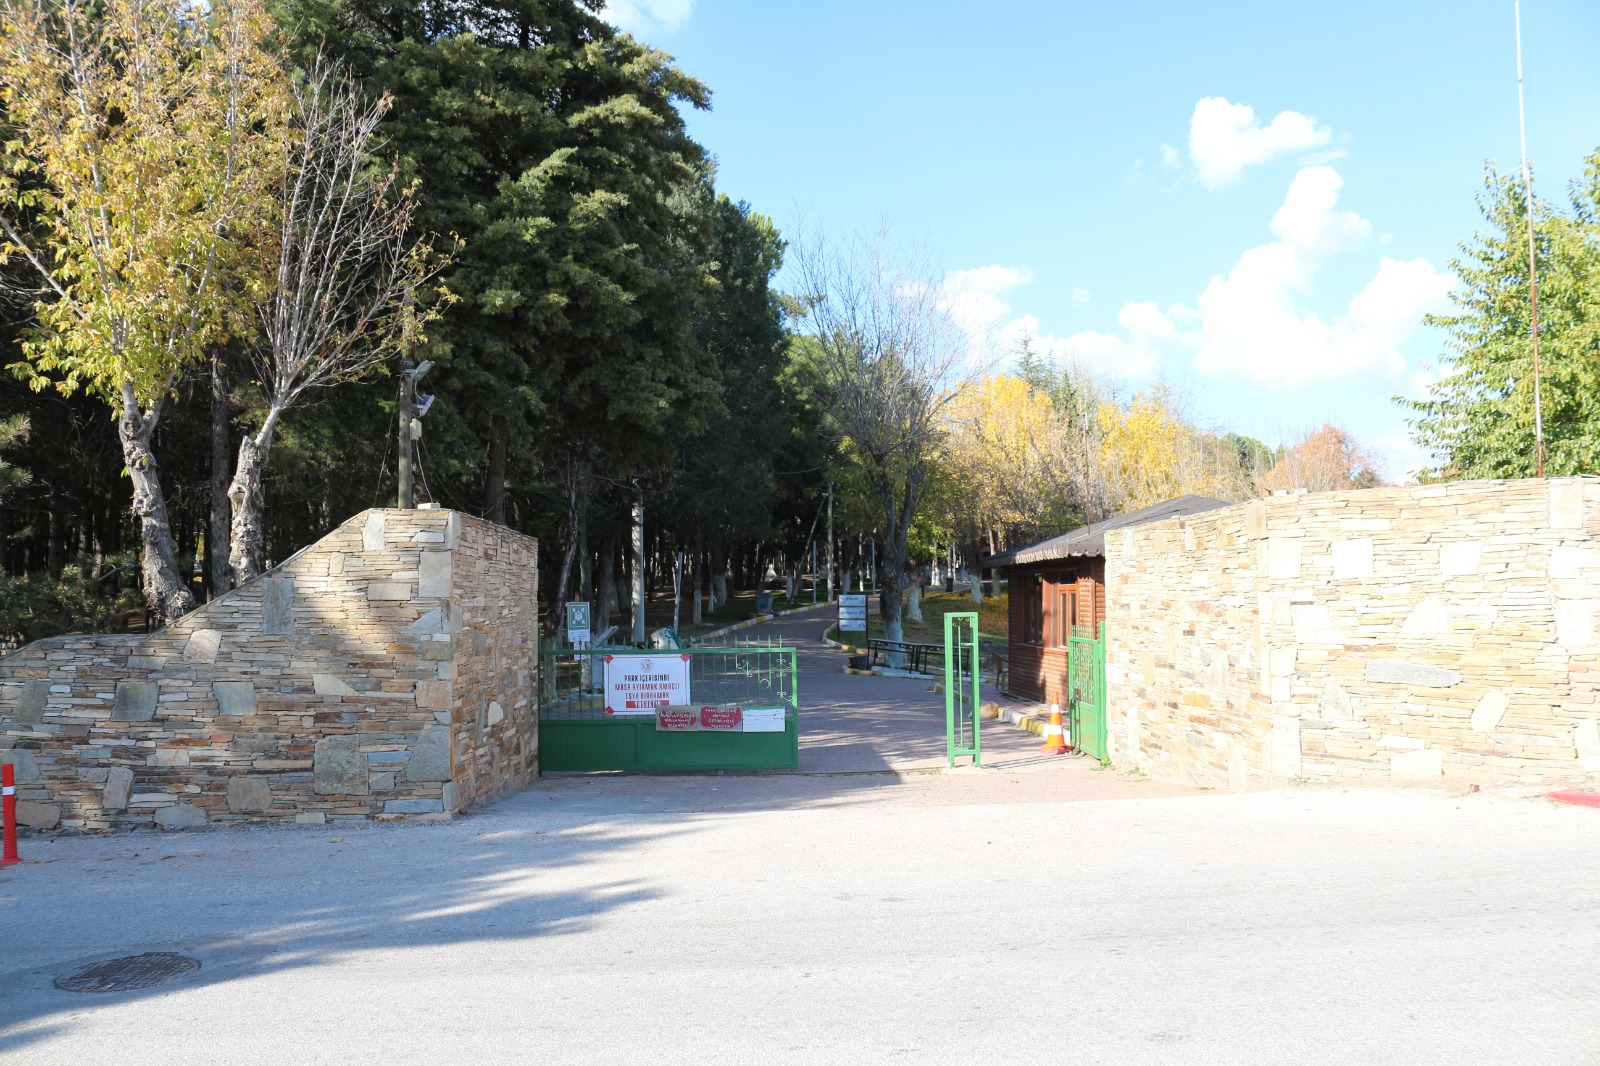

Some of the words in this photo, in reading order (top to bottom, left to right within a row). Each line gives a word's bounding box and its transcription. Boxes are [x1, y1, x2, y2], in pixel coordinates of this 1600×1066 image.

[624, 674, 638, 682] PARK
[640, 673, 670, 682] İÇERİSİNDE
[615, 683, 631, 691] MASA
[659, 682, 680, 691] AMAÇLI
